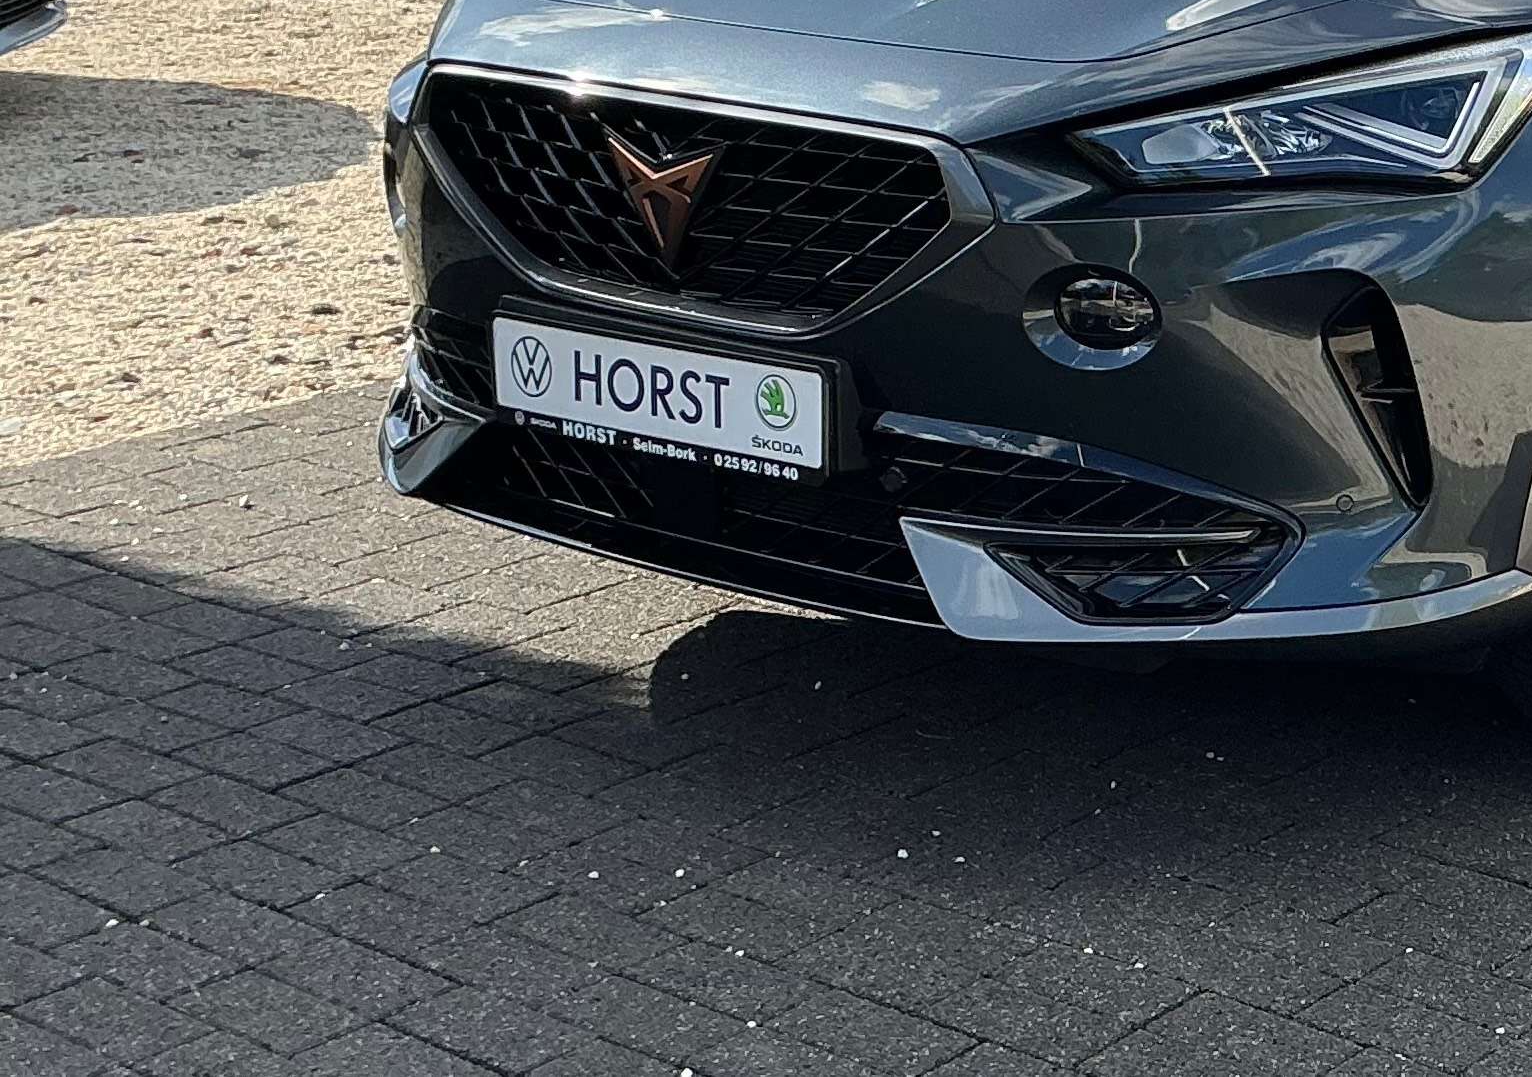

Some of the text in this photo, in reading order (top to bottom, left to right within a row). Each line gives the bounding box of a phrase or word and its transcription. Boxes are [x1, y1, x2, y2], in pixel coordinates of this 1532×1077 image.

[573, 349, 730, 429] HORST
[562, 419, 617, 446] HORST
[632, 436, 697, 463] Selm-Bork
[751, 434, 804, 457] ŠKODA
